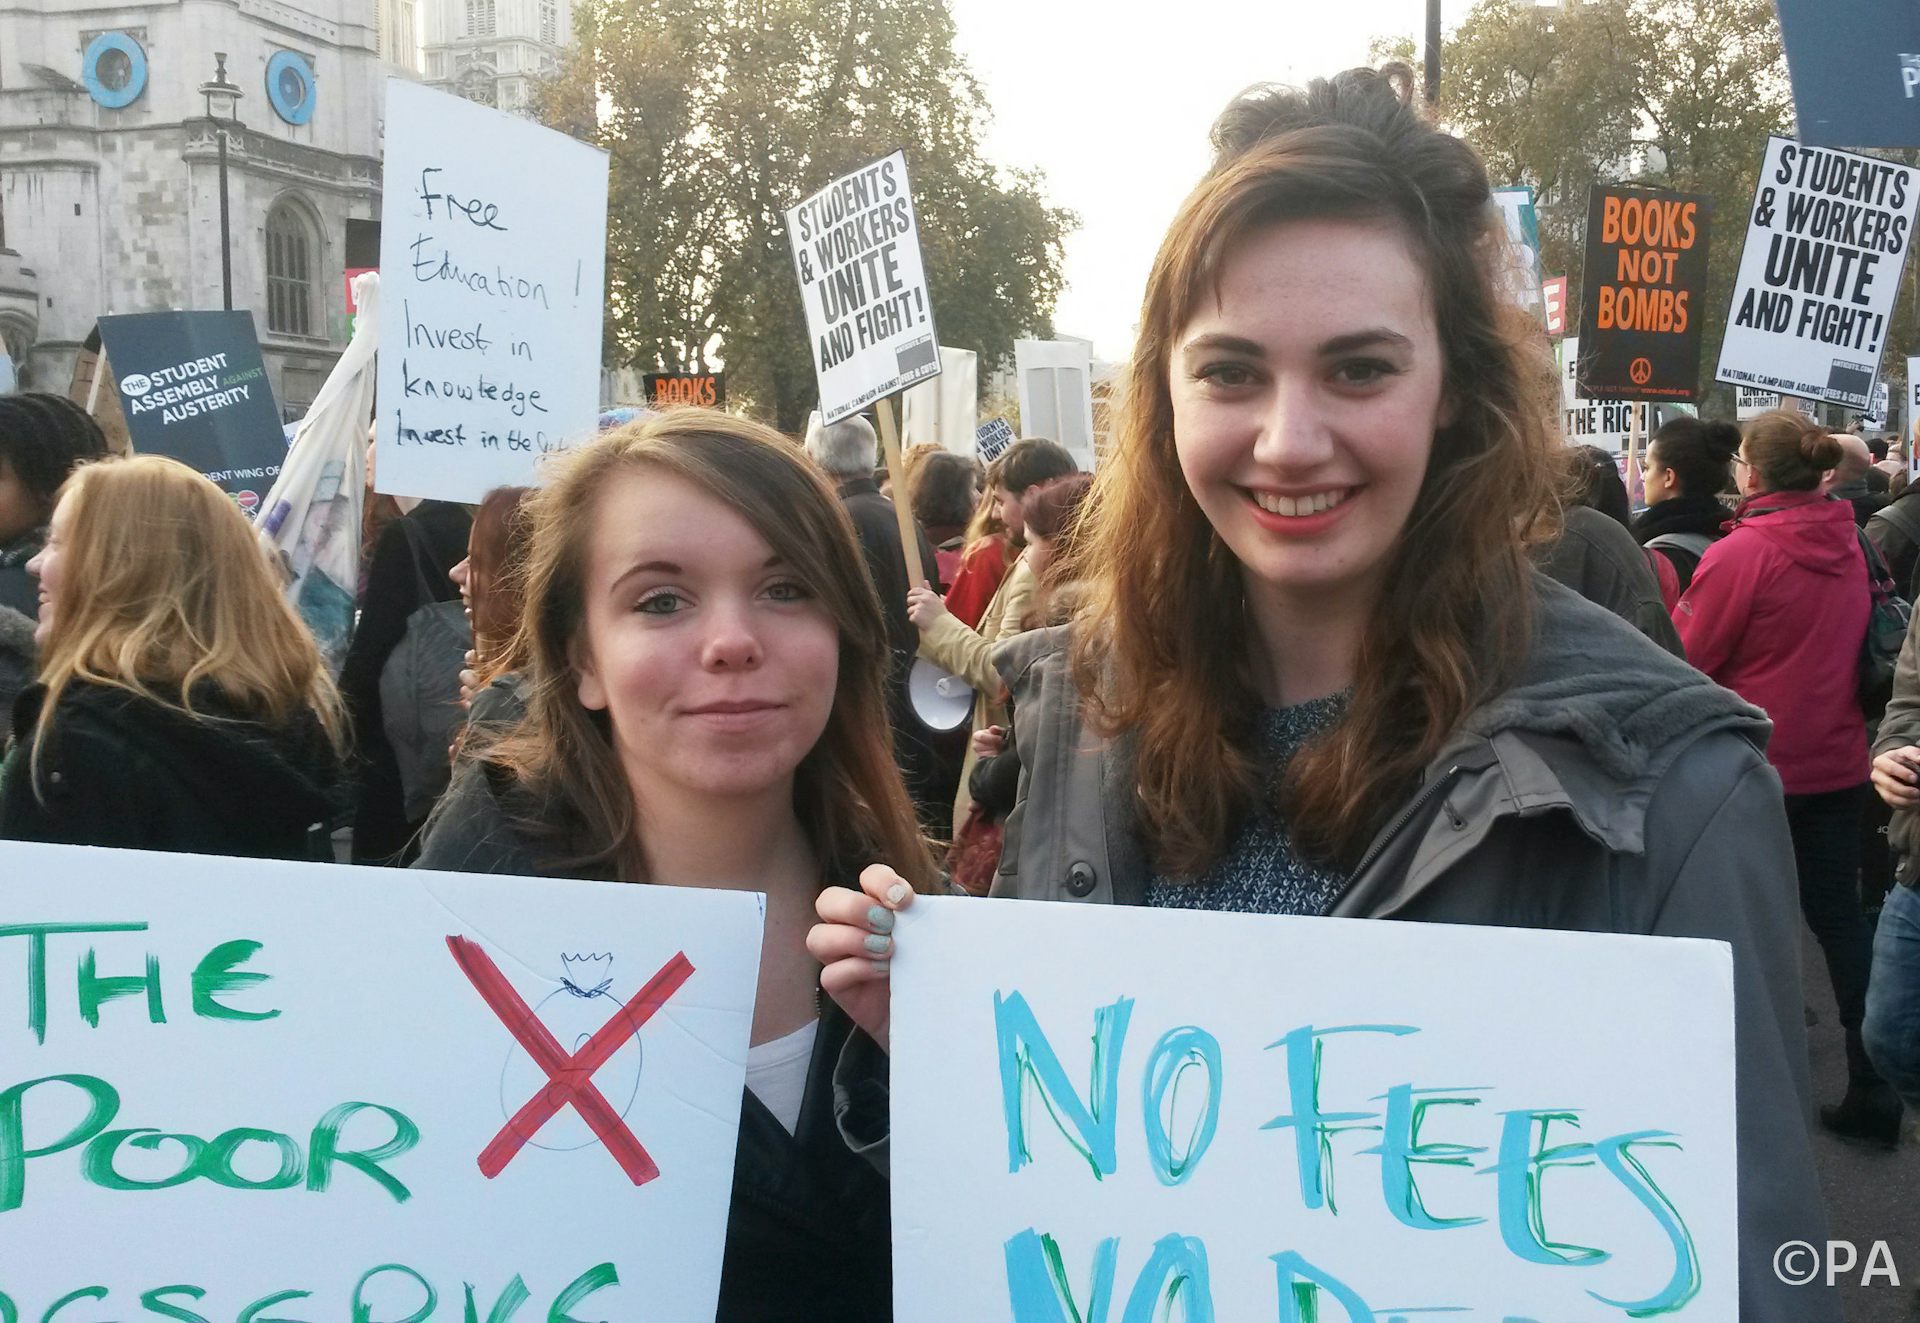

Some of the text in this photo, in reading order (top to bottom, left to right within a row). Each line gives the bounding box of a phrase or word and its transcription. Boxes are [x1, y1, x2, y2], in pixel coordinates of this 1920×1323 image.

[420, 168, 508, 231] Free
[797, 160, 898, 242] STUDENTS
[1775, 145, 1910, 210] STUDENTS
[799, 197, 910, 286] & WORKERS
[1602, 195, 1697, 250] BOOKS
[1754, 187, 1907, 255] & WORKERS
[410, 233, 549, 310] Education
[818, 241, 903, 326] UNITE
[1617, 249, 1679, 286] NOT
[1764, 233, 1880, 306] UNITE
[404, 299, 493, 352] Invest
[511, 331, 533, 361] in
[821, 286, 926, 373] AND FIGHT!
[1597, 285, 1689, 334] BOMBS
[1735, 287, 1883, 353] AND FIGHT!
[123, 353, 228, 392] THE STUDENT
[131, 367, 264, 415] ASSEMBLY AGAINST
[655, 376, 716, 405] BOOKS
[826, 404, 852, 420] NATIONAL
[851, 389, 877, 408] CAMPAIGN
[877, 376, 900, 395] AGAINST
[1722, 367, 1757, 383] NATIONAL
[1757, 375, 1795, 390] CAMPAIGN
[1797, 383, 1825, 397] AGAINST
[163, 385, 250, 425] AUSTERITY
[397, 408, 467, 446] Invest
[481, 431, 500, 450] in
[977, 417, 1005, 440] TUDENTS
[1565, 407, 1597, 436] THE
[1738, 396, 1777, 407] AND FIGHT!
[979, 425, 1012, 449] WORKERS
[204, 469, 233, 483] DENT
[233, 466, 264, 479] WING
[0, 920, 282, 1046] THE
[0, 1073, 422, 1211] POOR
[993, 988, 1703, 1319] NO FEES
